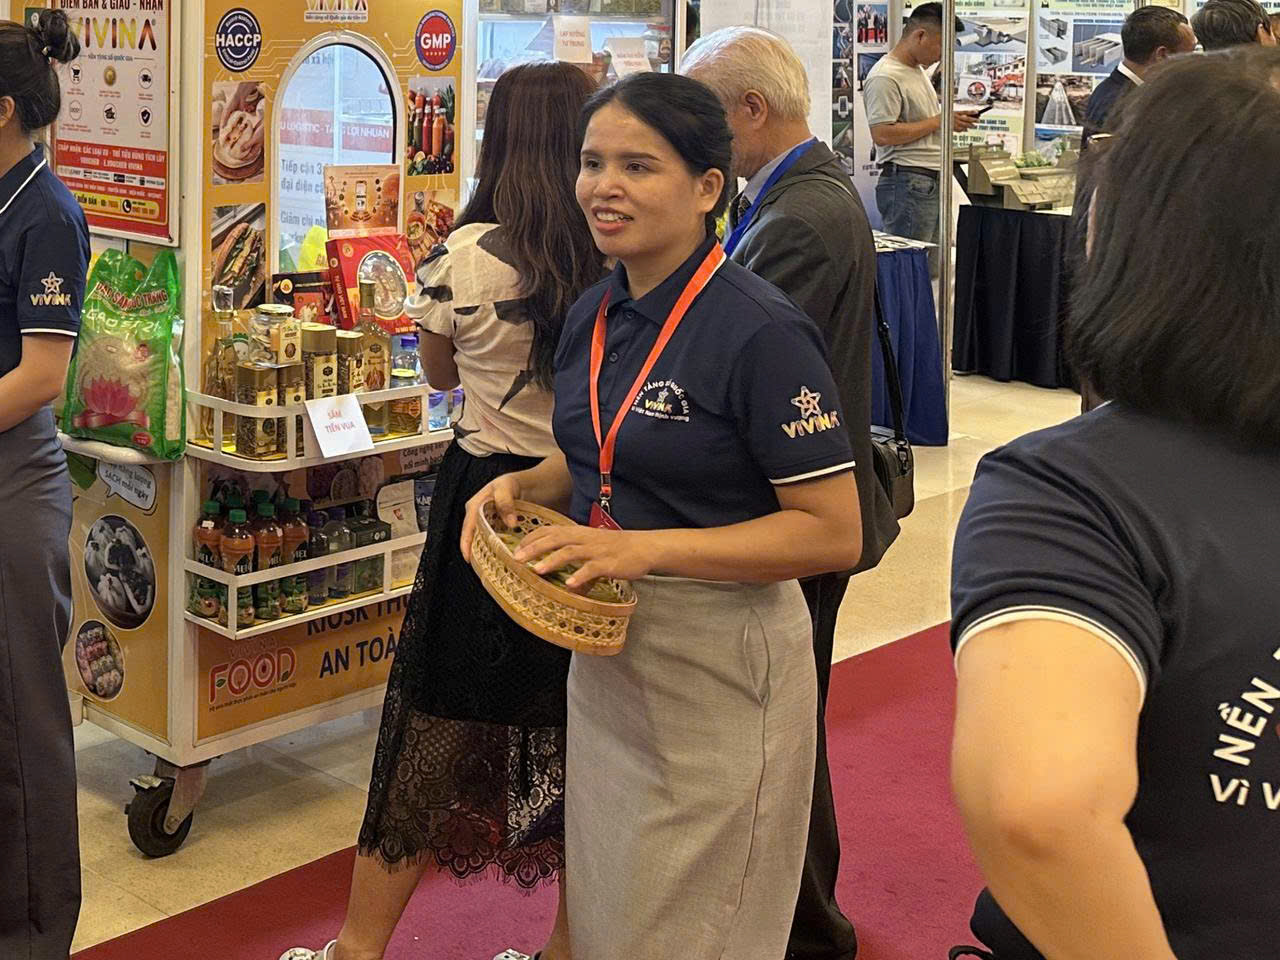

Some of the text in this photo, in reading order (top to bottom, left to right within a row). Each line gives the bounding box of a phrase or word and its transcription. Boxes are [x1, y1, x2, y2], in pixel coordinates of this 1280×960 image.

[216, 33, 261, 47] HACCP
[420, 33, 451, 49] GMP
[281, 159, 298, 174] Tiếp
[782, 410, 840, 439] VIVINA
[319, 626, 398, 679] AN TOÀ
[208, 646, 297, 705] FOOD
